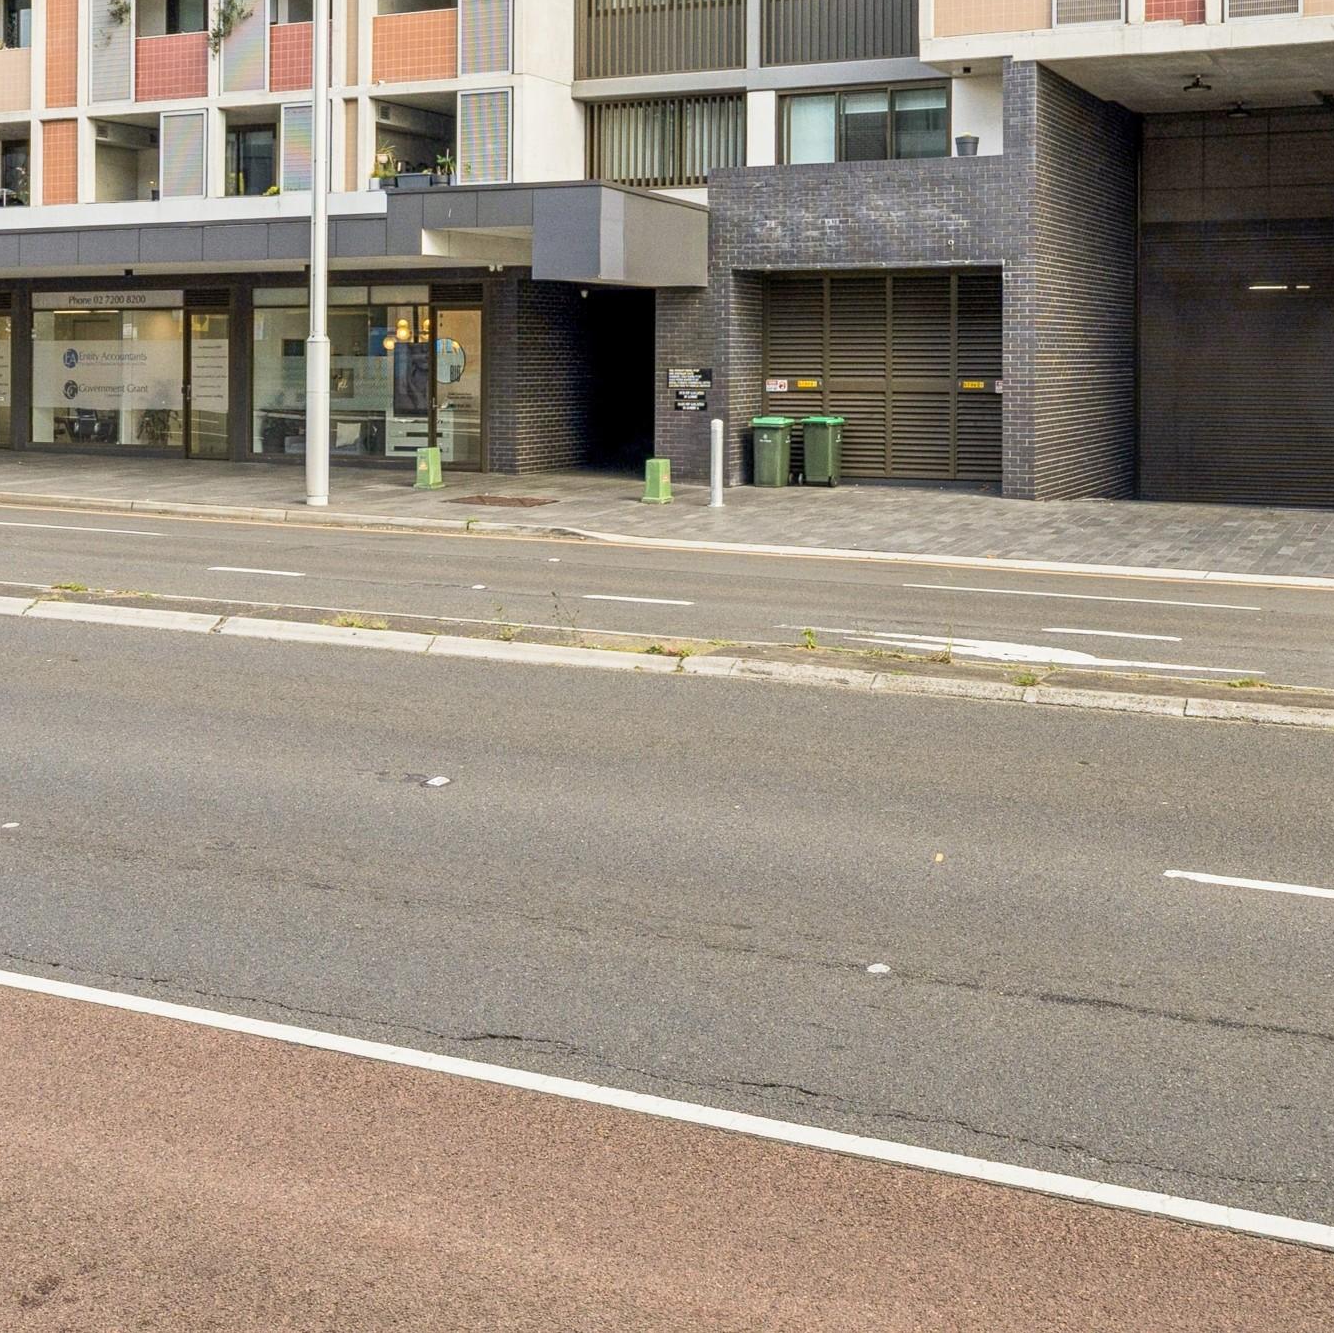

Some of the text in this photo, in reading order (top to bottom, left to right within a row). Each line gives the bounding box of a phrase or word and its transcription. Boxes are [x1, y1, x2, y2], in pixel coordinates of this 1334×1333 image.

[69, 294, 146, 305] Phone 02 7200 8200
[101, 351, 147, 361] Accountants
[78, 383, 148, 393] Government Grant
